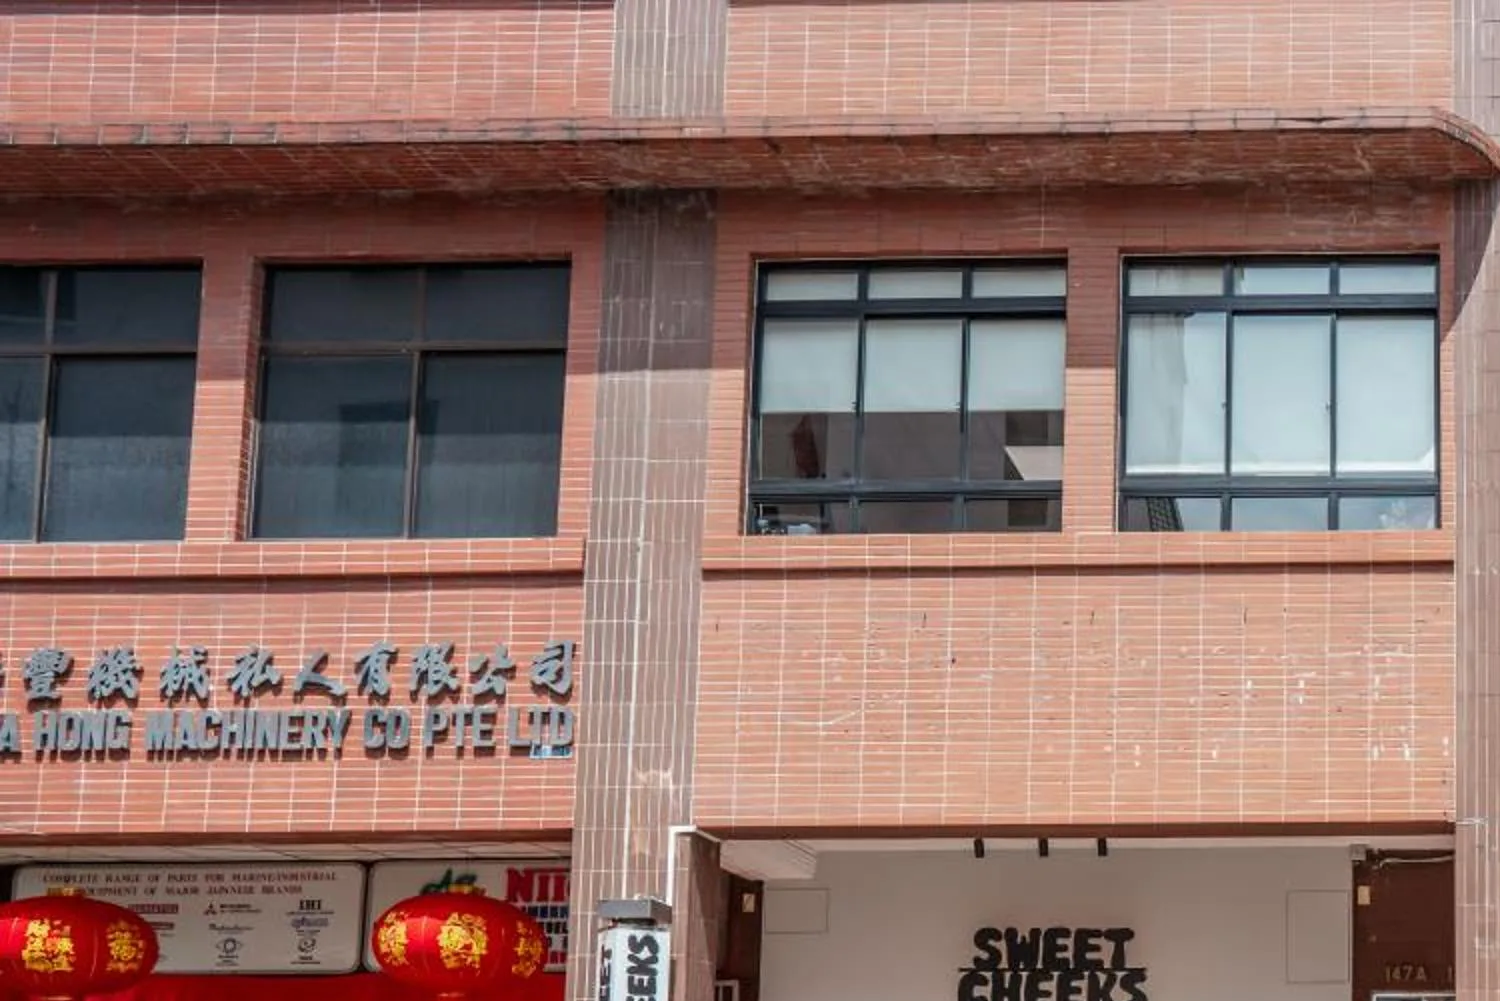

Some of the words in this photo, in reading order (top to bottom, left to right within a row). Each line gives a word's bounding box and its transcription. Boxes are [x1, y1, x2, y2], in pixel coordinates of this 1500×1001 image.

[0, 639, 575, 700] 豐機械私人有限公司
[34, 709, 132, 751] HONG
[144, 707, 351, 750] MACHINERY
[363, 707, 411, 748] CO
[425, 705, 497, 749] PTE
[508, 703, 576, 746] LTD
[507, 867, 571, 902] NII
[972, 927, 1135, 971] SWEET
[1386, 964, 1428, 982] 147A
